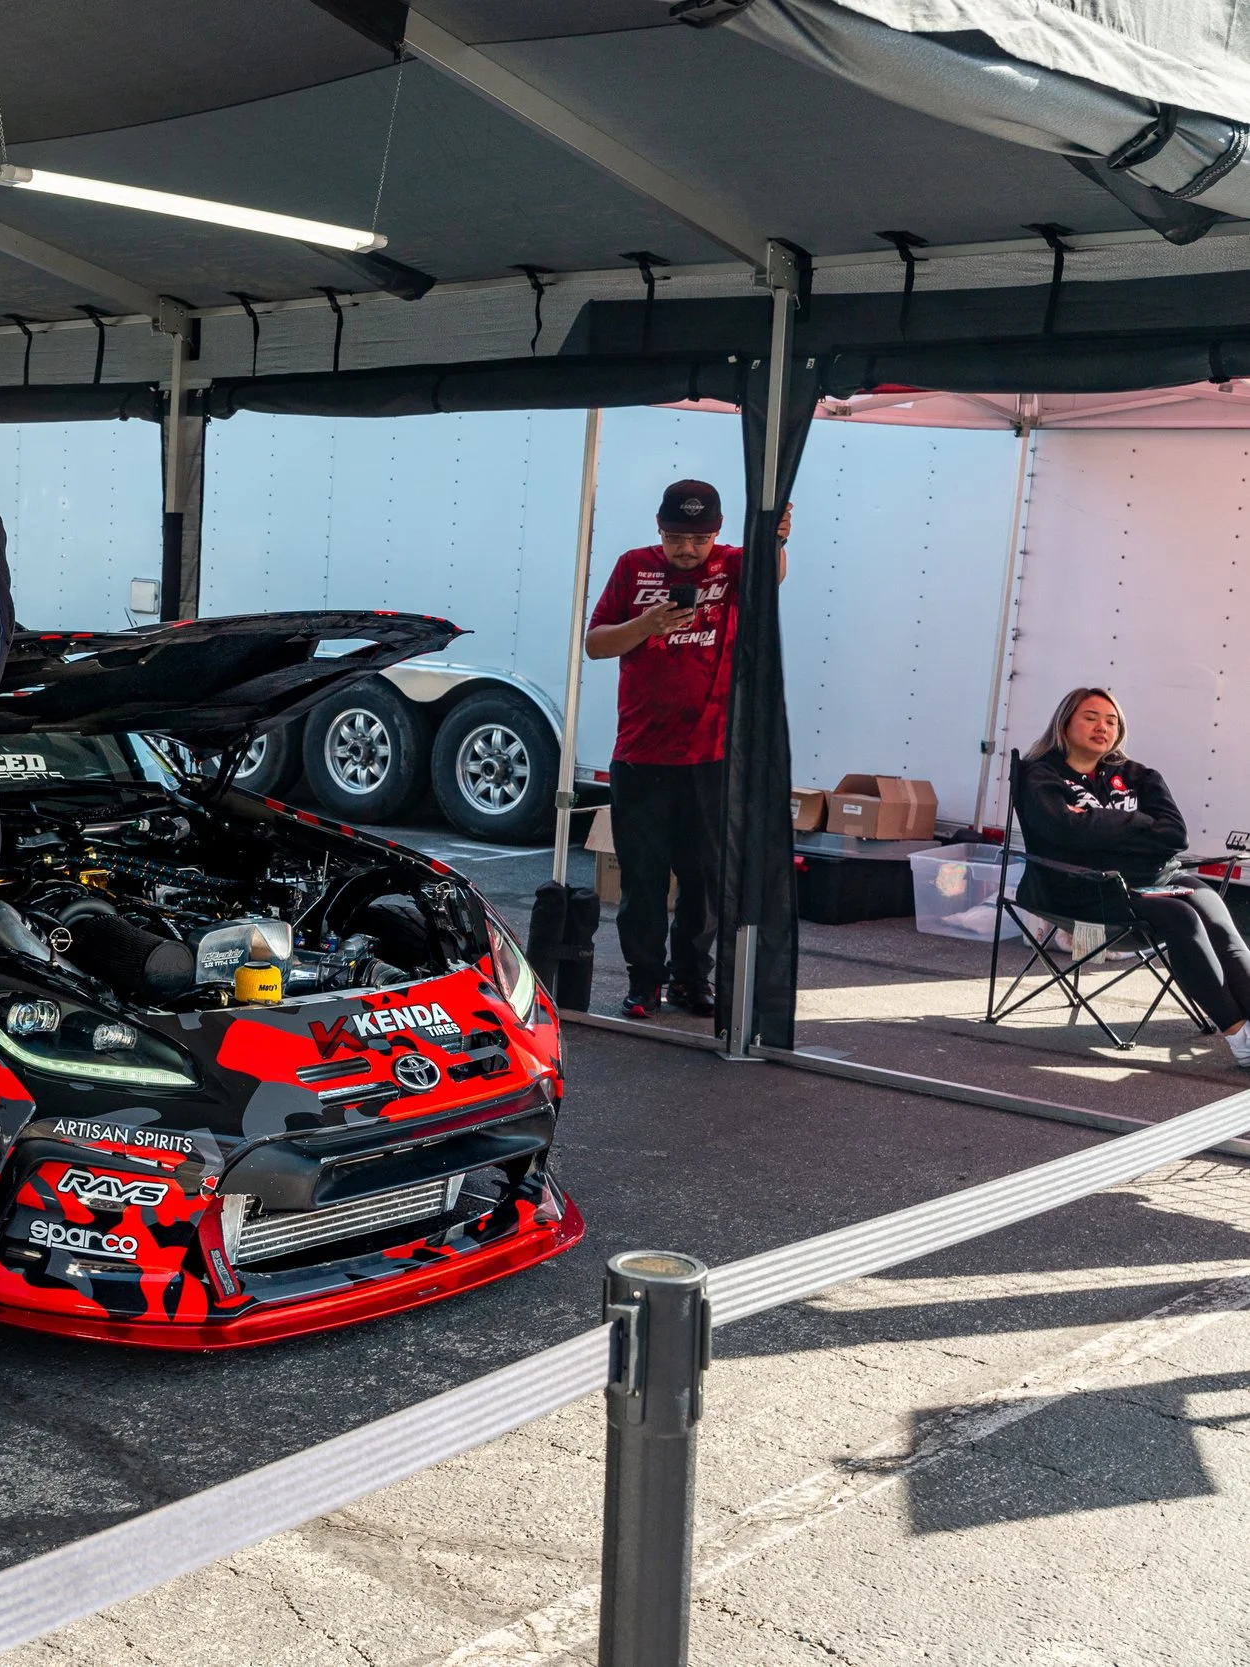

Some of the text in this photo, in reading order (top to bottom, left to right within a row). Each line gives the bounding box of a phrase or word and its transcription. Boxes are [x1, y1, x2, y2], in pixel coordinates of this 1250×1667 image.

[668, 629, 717, 645] KENDA
[257, 984, 278, 992] Moty's
[352, 1002, 453, 1038] KENDA
[425, 1022, 461, 1038] TIRES
[52, 1118, 194, 1153] ARTISAN SPIRITS
[57, 1168, 169, 1206] RAYS
[29, 1219, 138, 1256] sparco
[211, 1250, 235, 1296] sparco
